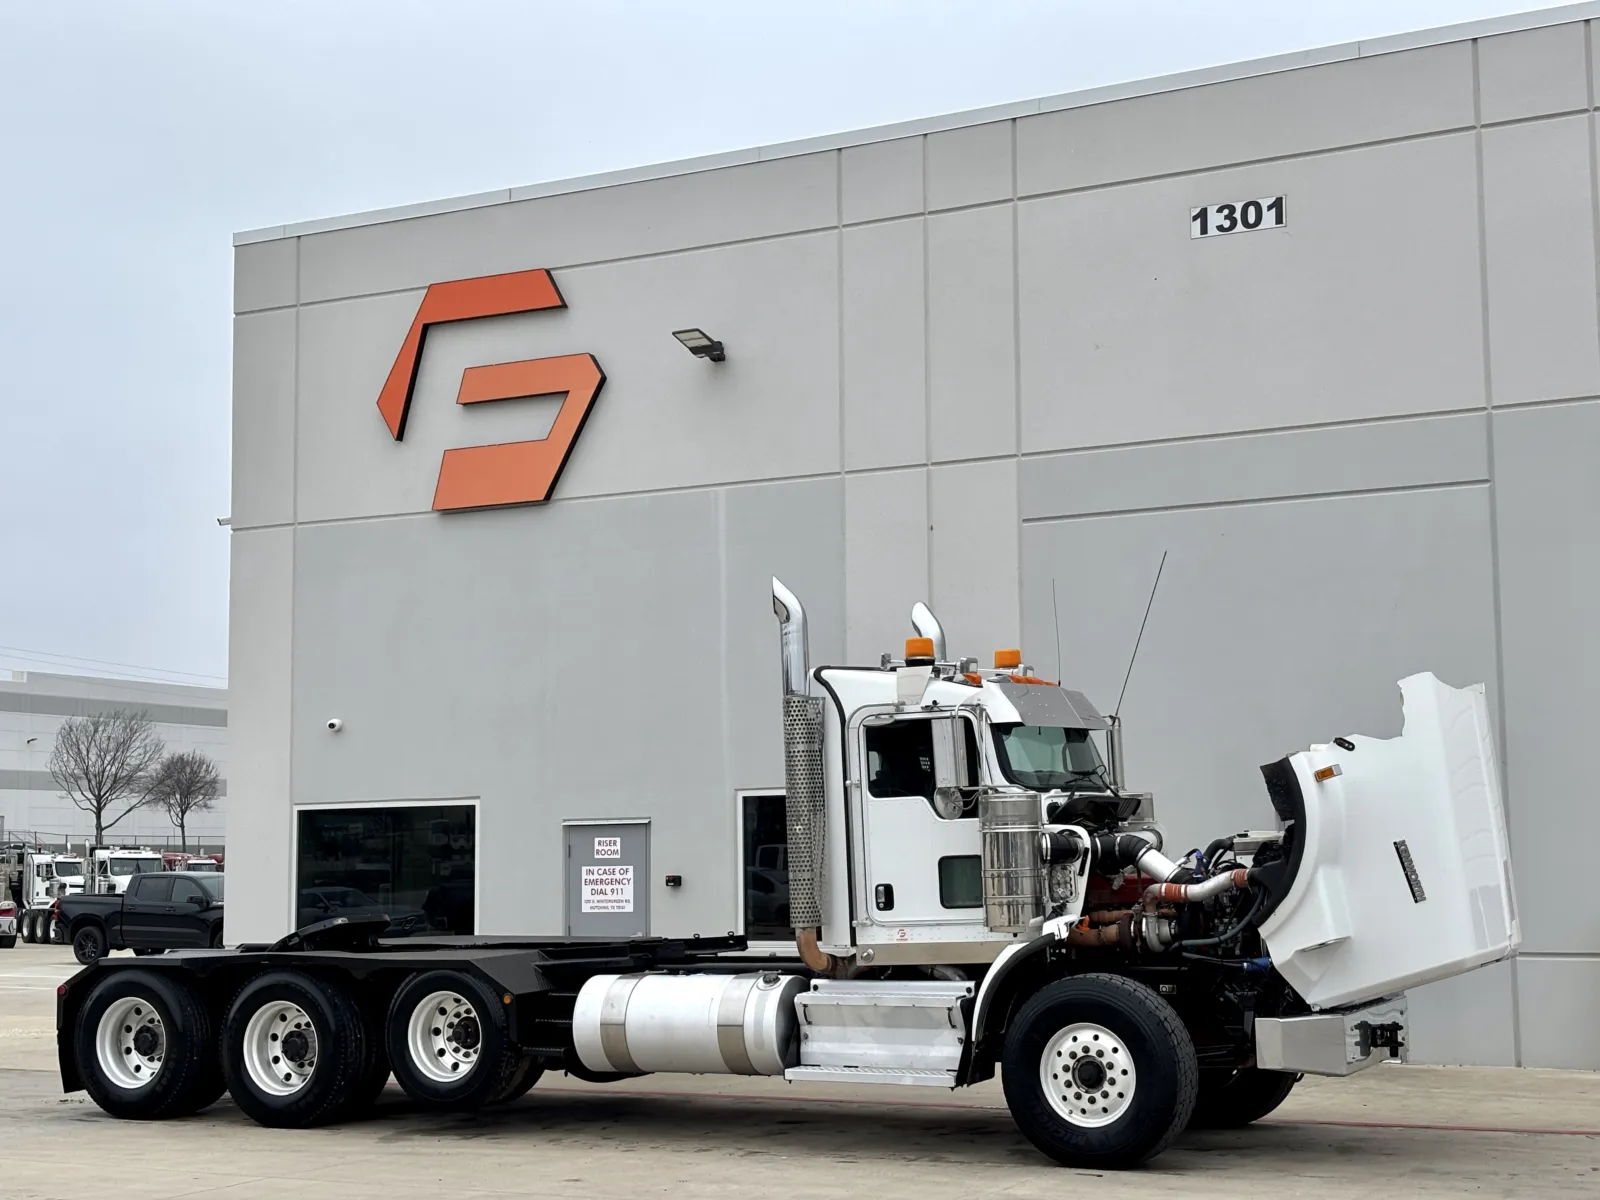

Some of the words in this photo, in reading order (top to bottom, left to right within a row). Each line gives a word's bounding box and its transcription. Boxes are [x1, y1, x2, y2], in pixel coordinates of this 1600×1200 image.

[1192, 196, 1284, 235] 1301
[595, 848, 619, 856] ROOM
[585, 868, 594, 876] IN
[596, 868, 616, 876] CASE
[1395, 839, 1427, 903] KENWORTH
[584, 878, 631, 886] EMERGENCY
[590, 888, 608, 896] DIAL
